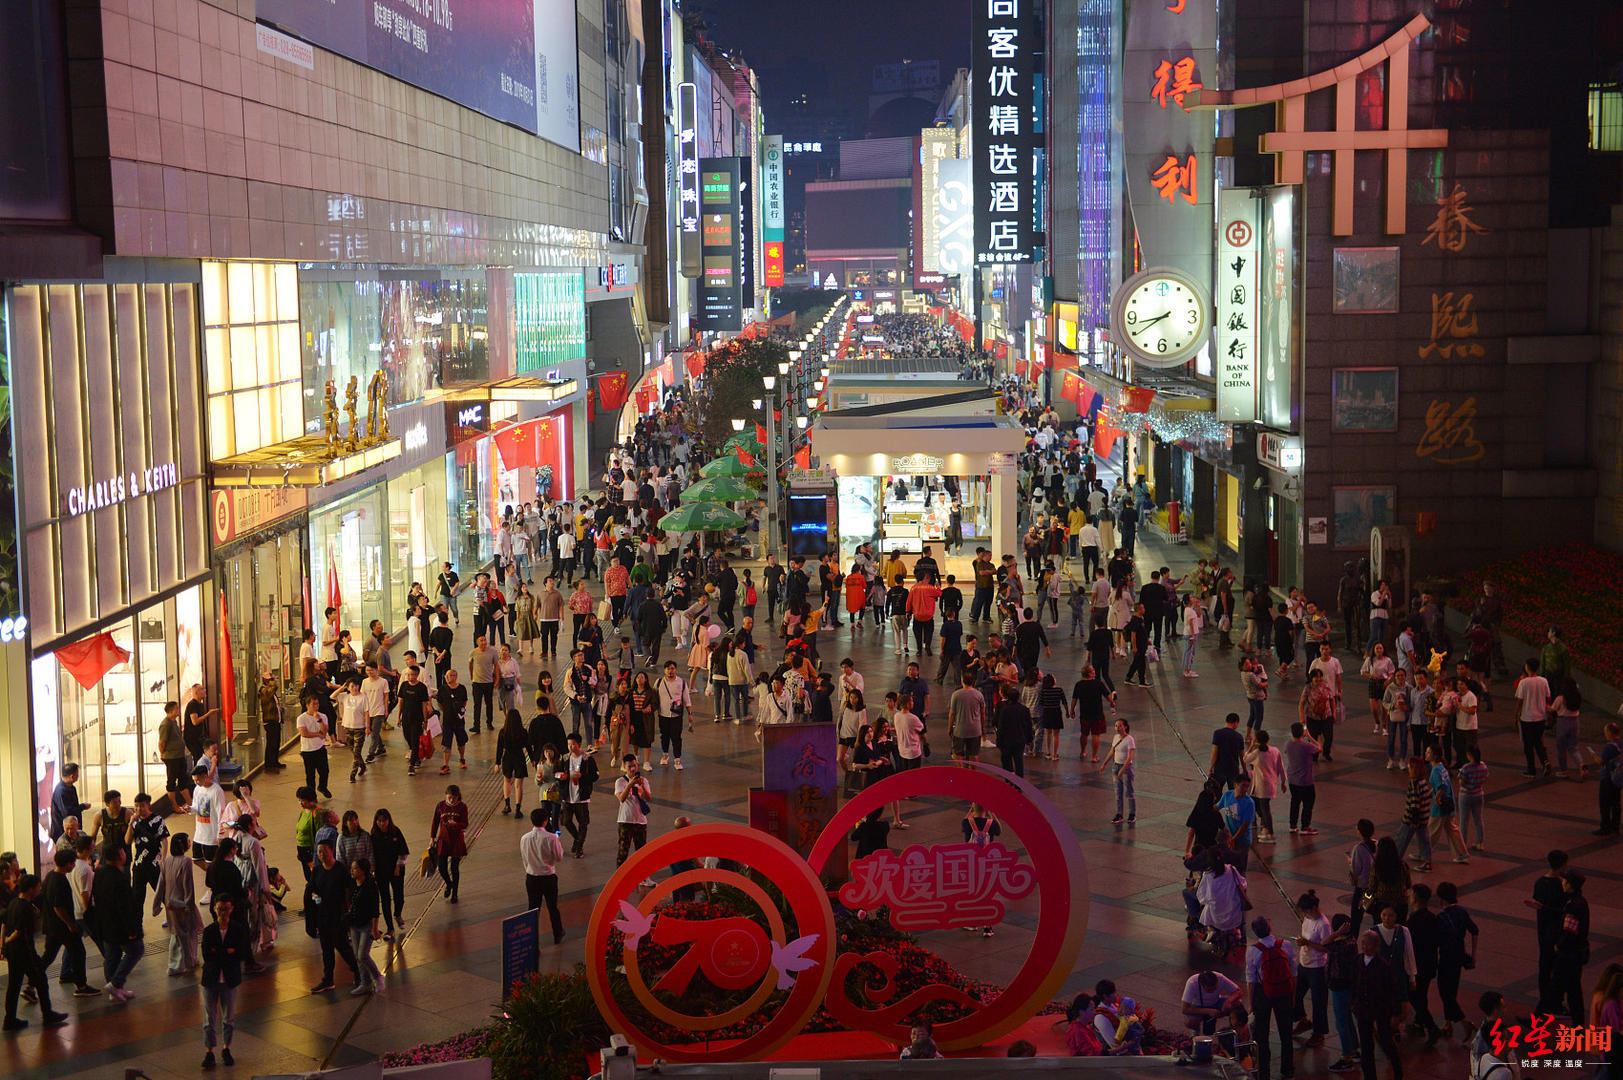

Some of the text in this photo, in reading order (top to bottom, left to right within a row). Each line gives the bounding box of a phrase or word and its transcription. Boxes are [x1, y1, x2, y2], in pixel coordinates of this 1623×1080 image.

[1151, 0, 1204, 206] 得利
[769, 162, 780, 219] 中国农业银行
[939, 180, 972, 272] GXG
[1127, 311, 1197, 326] 9 3
[1416, 185, 1493, 464] 春熙路
[1157, 338, 1167, 353] 6
[458, 404, 482, 427] MAC
[68, 463, 177, 517] CHARLES & KEITH
[0, 615, 28, 643] ee
[854, 847, 1032, 900] 欢度国庆
